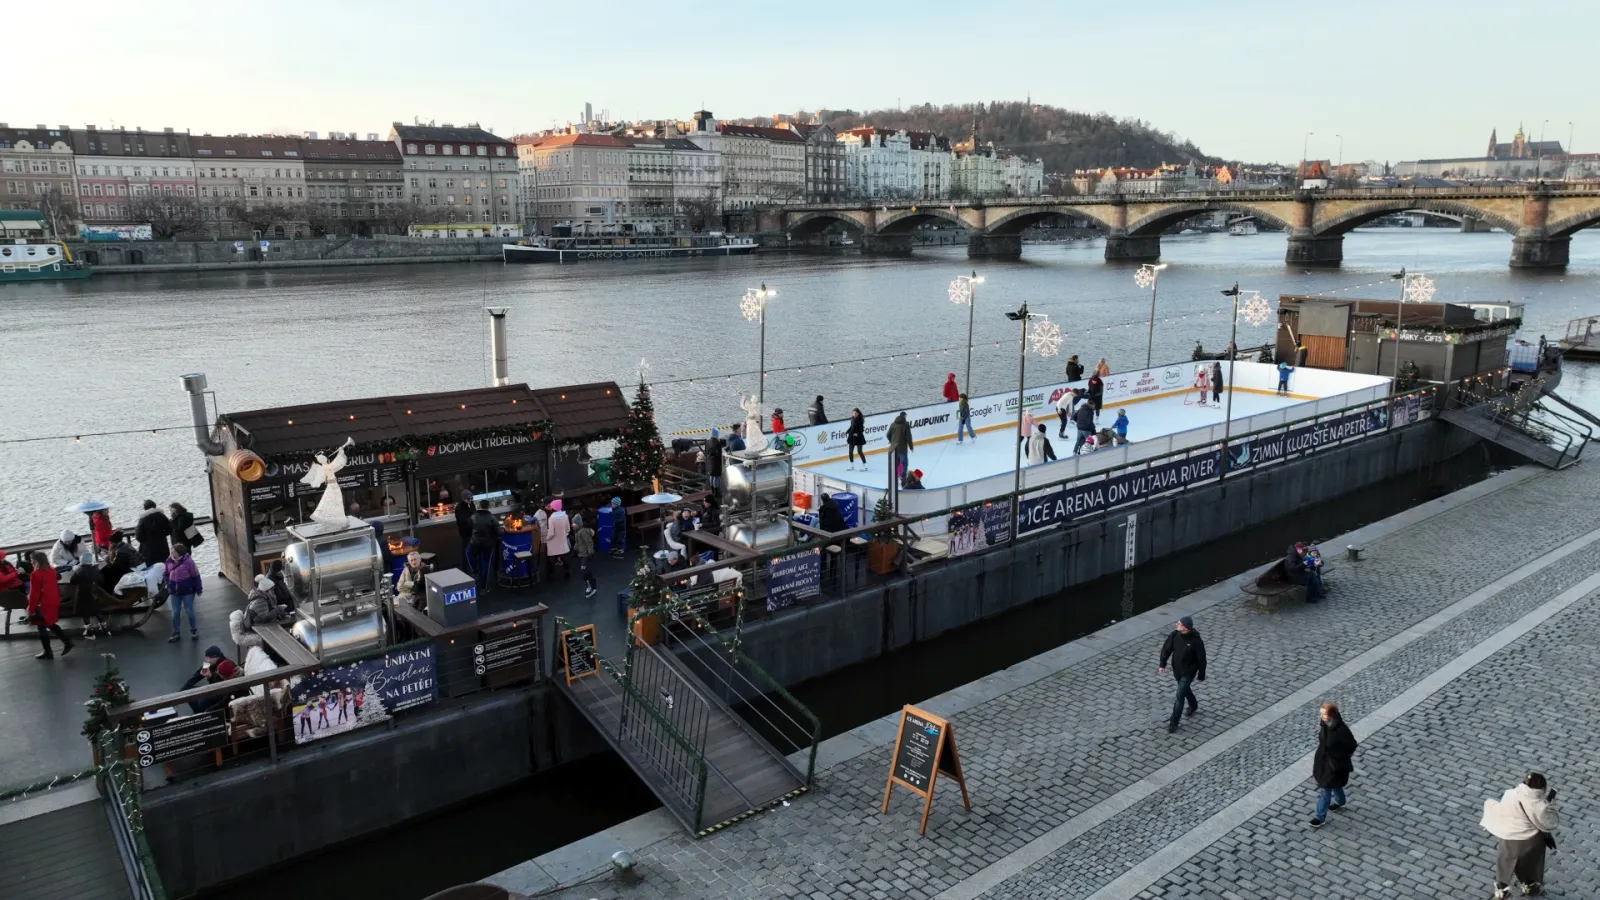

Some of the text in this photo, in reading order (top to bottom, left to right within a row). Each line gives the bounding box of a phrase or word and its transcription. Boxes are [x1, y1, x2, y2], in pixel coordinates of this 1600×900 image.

[577, 249, 673, 259] CARGO GALLERY
[1424, 333, 1443, 343] GIFTS
[969, 404, 993, 417] Google
[993, 403, 1002, 412] TV
[909, 413, 950, 429] LAUPUNKT
[1252, 434, 1285, 463] ZIMNÍ
[282, 461, 311, 476] MAS
[1027, 502, 1051, 526] ICE
[1053, 489, 1105, 519] ARENA
[1107, 484, 1130, 502] ON
[1131, 469, 1178, 497] VLTAVA
[1179, 458, 1214, 482] RIVER
[450, 589, 472, 603] ATM
[386, 688, 400, 700] NA
